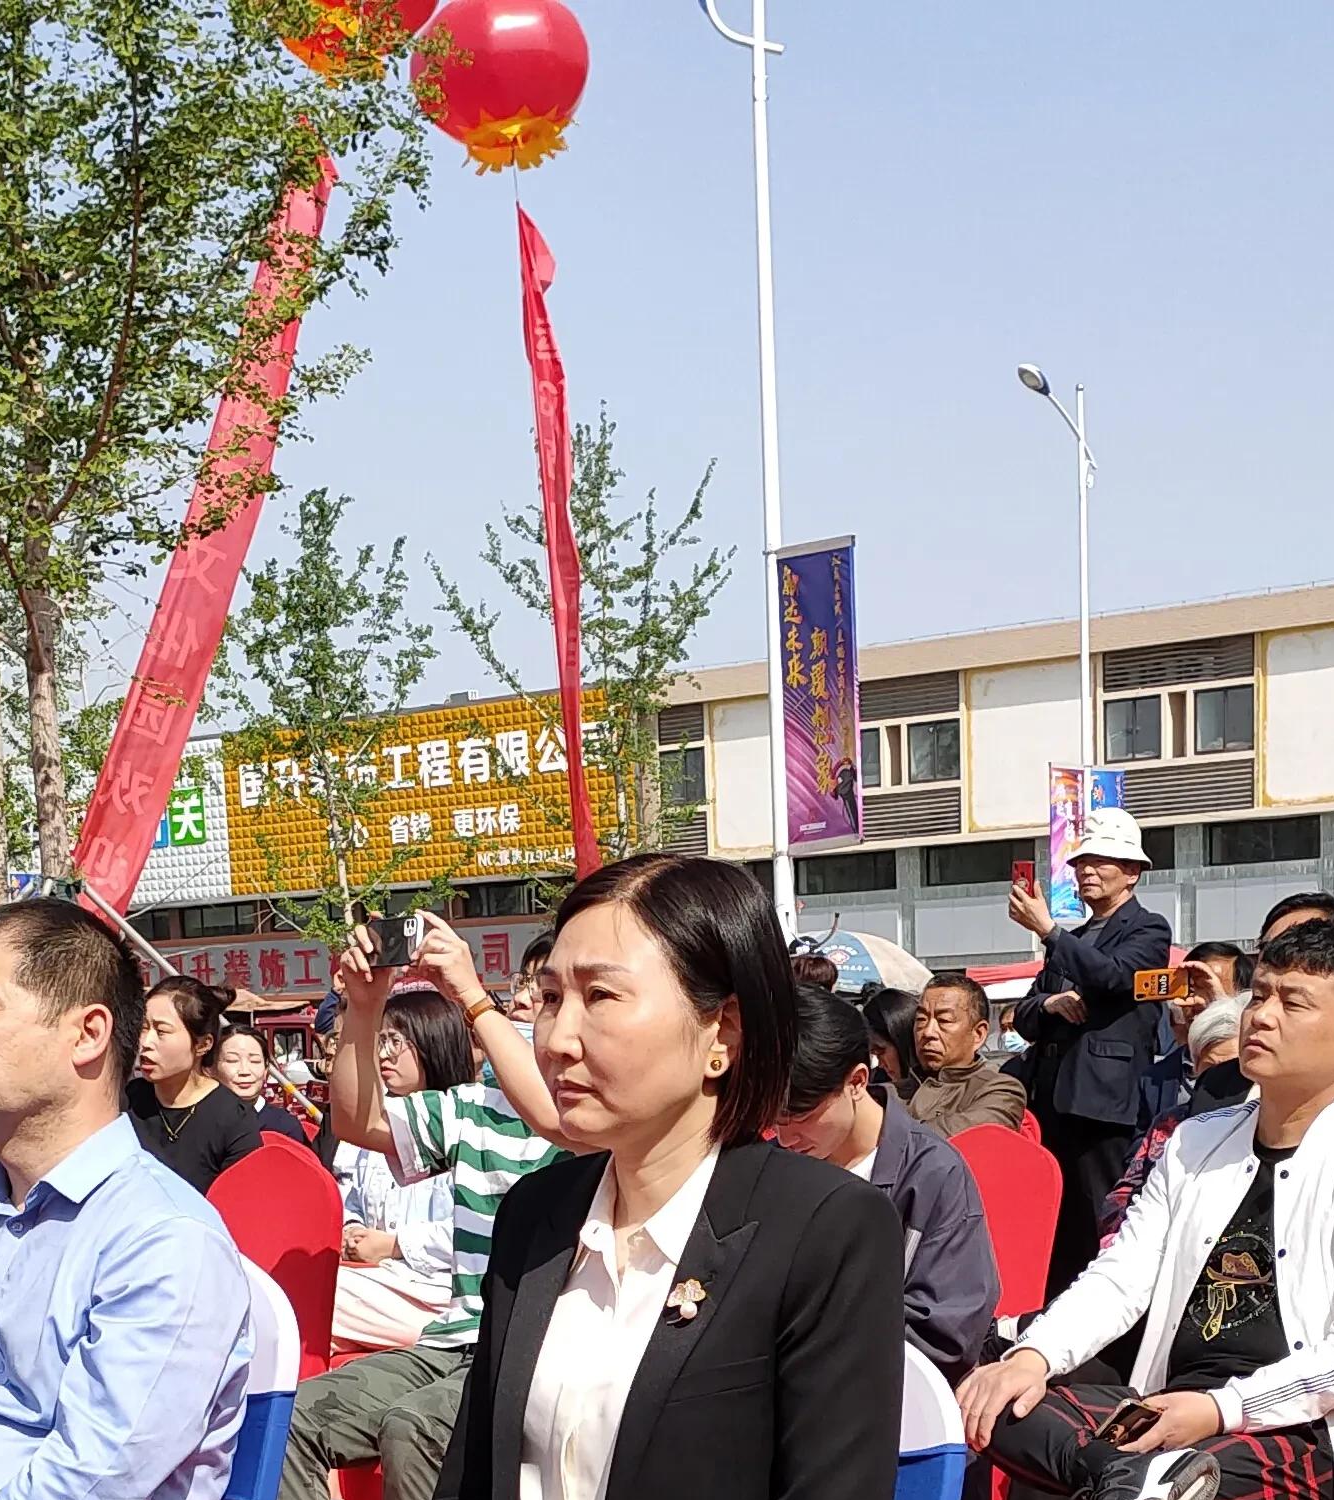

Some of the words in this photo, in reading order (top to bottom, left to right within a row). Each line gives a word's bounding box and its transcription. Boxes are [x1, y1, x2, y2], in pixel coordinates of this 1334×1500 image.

[156, 793, 203, 841] 关
[389, 812, 432, 845] 省钱
[453, 804, 520, 838] 更环保
